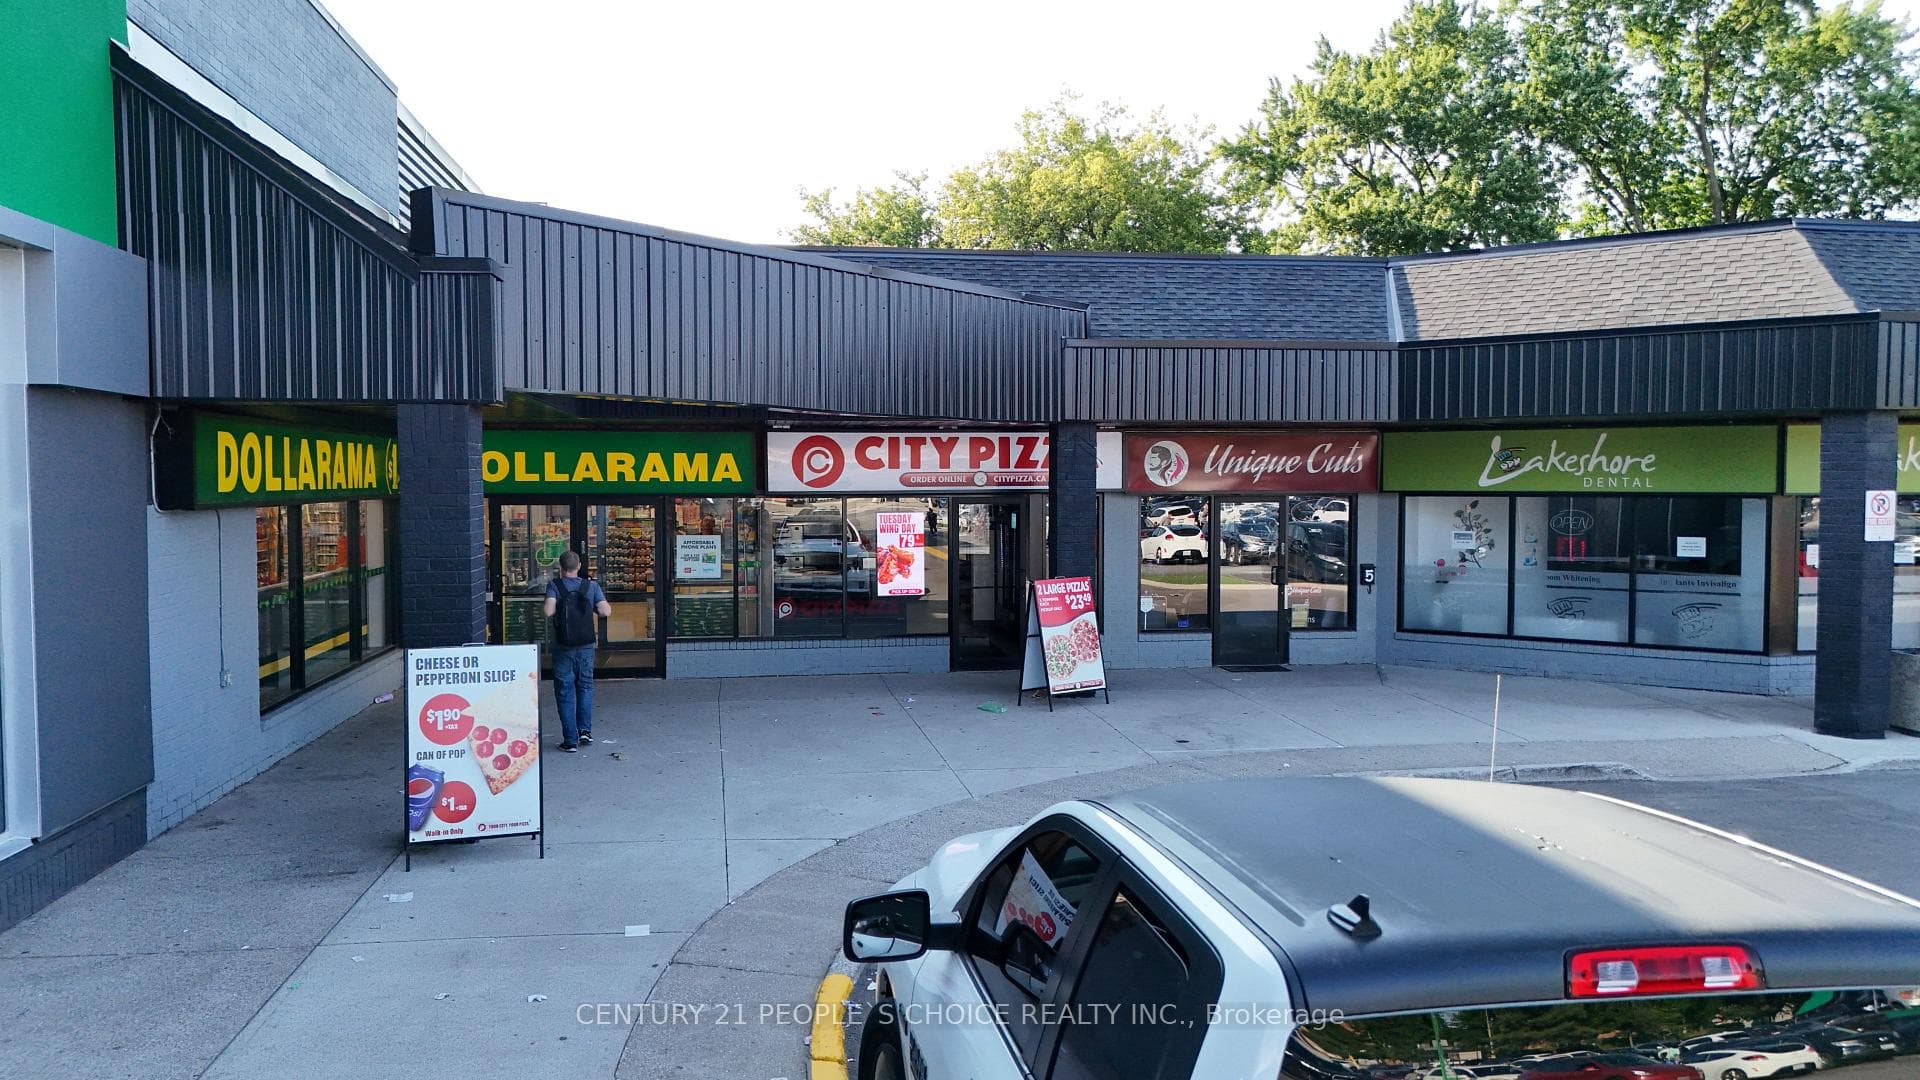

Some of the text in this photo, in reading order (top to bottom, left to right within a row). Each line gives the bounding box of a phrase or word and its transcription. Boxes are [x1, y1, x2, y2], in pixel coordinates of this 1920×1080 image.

[855, 436, 1049, 470] CITY PIZ
[1478, 432, 1656, 487] Lakeshore
[217, 431, 377, 493] DOLLARAMA
[482, 450, 743, 483] OLLARAMA
[1204, 440, 1364, 484] Unique Cuts
[910, 475, 1047, 483] ORDER ONLINE CITYPIZZA.CA
[1583, 477, 1653, 488] DENTAL
[879, 514, 912, 523] TUESDAY
[1552, 516, 1590, 529] OPEN
[879, 524, 916, 534] WING DAY
[1365, 570, 1374, 582] 5
[1562, 574, 1600, 584] Whitening
[1037, 581, 1090, 595] 2 LARGE PIZZAS
[416, 656, 479, 670] CHEESE OR
[416, 670, 516, 686] PEPPERONI SLICE
[416, 749, 465, 760] CAN OF POP
